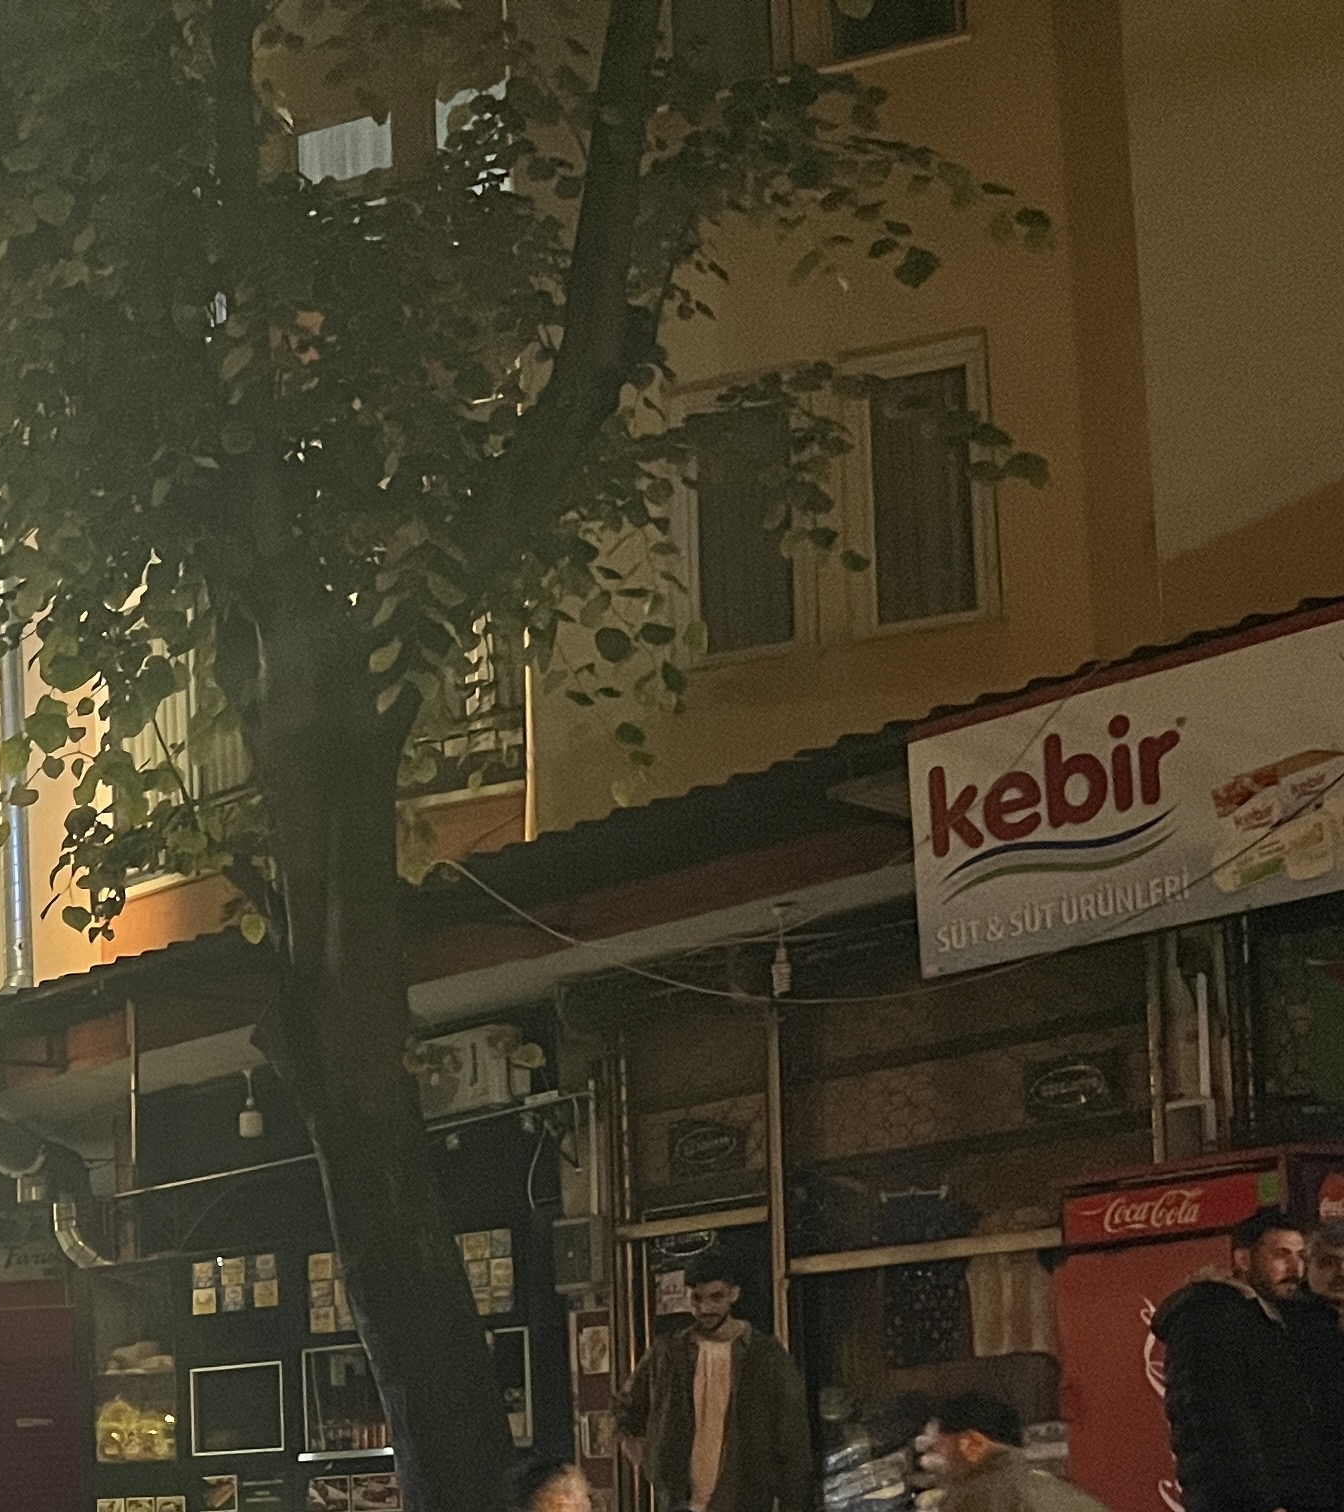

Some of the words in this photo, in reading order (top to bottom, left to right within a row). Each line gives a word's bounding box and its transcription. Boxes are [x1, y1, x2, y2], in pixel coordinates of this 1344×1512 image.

[927, 714, 1180, 858] kebir
[935, 917, 980, 952] SÜT
[986, 915, 1004, 942] &
[1009, 899, 1056, 937] SÜT
